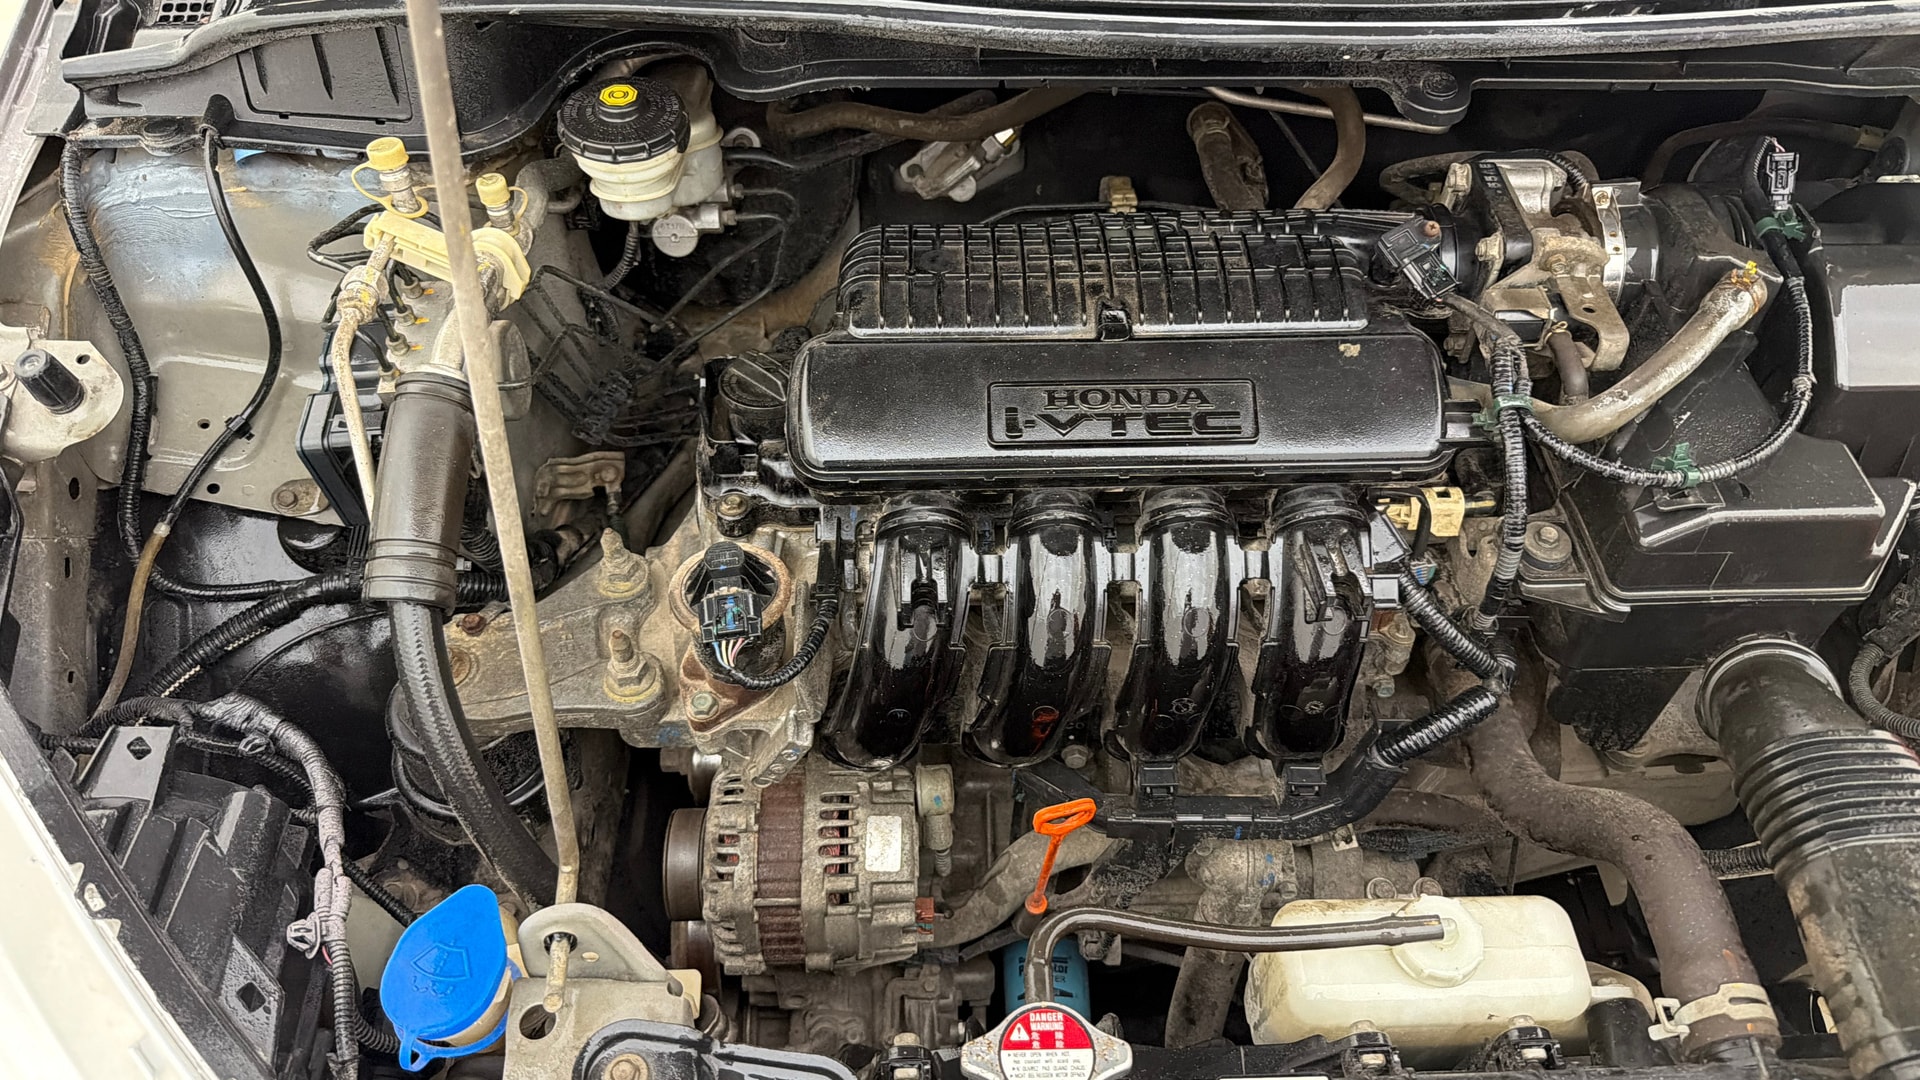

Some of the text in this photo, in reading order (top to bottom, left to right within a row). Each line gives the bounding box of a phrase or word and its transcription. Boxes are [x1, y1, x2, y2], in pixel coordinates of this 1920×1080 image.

[1043, 388, 1215, 411] HONDA
[1005, 406, 1243, 439] i-VTEC
[1029, 1012, 1064, 1022] DANGER
[1030, 1021, 1065, 1031] WARNUNG
